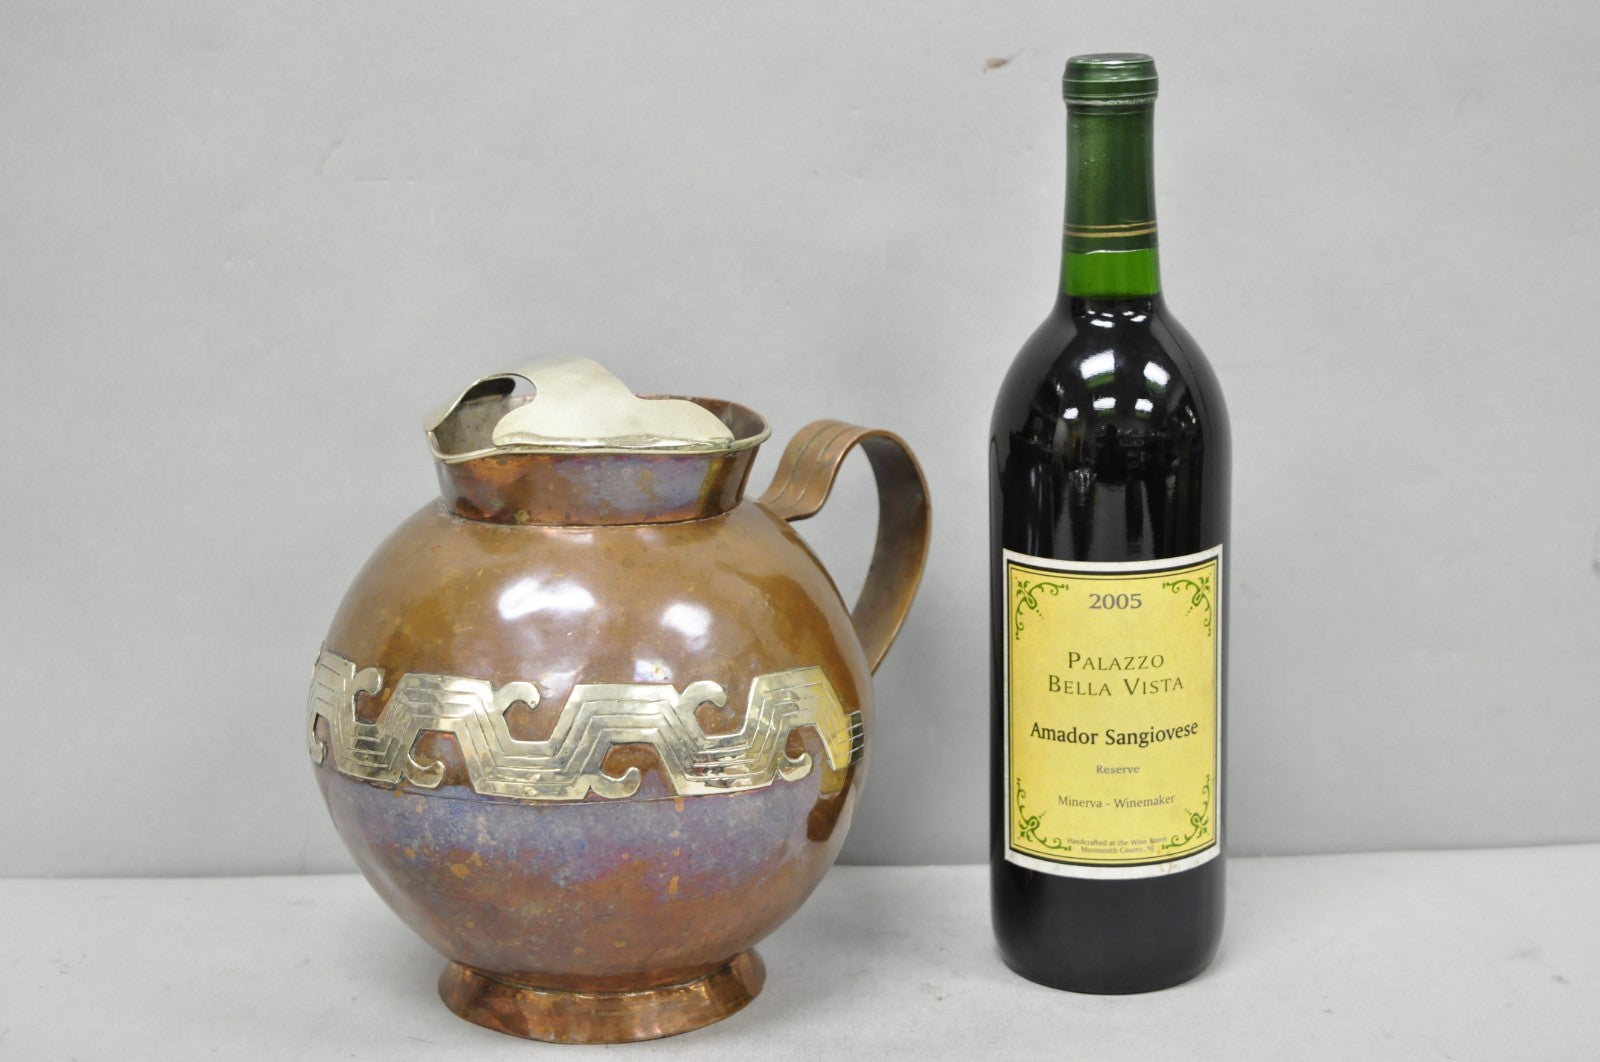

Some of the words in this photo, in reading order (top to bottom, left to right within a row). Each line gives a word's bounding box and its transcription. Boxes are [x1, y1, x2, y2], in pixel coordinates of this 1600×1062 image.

[1089, 593, 1142, 610] 2005
[1068, 651, 1164, 671] PALAZZO
[1048, 674, 1112, 696] BELLA
[1123, 677, 1183, 695] VISTA
[1030, 722, 1099, 745] Amador
[1105, 722, 1199, 748] Sangiovese
[1096, 764, 1140, 774] Reserve
[1058, 795, 1102, 808] Minerva
[1114, 795, 1175, 808] Winemaker
[1067, 837, 1107, 846] Handcrafted
